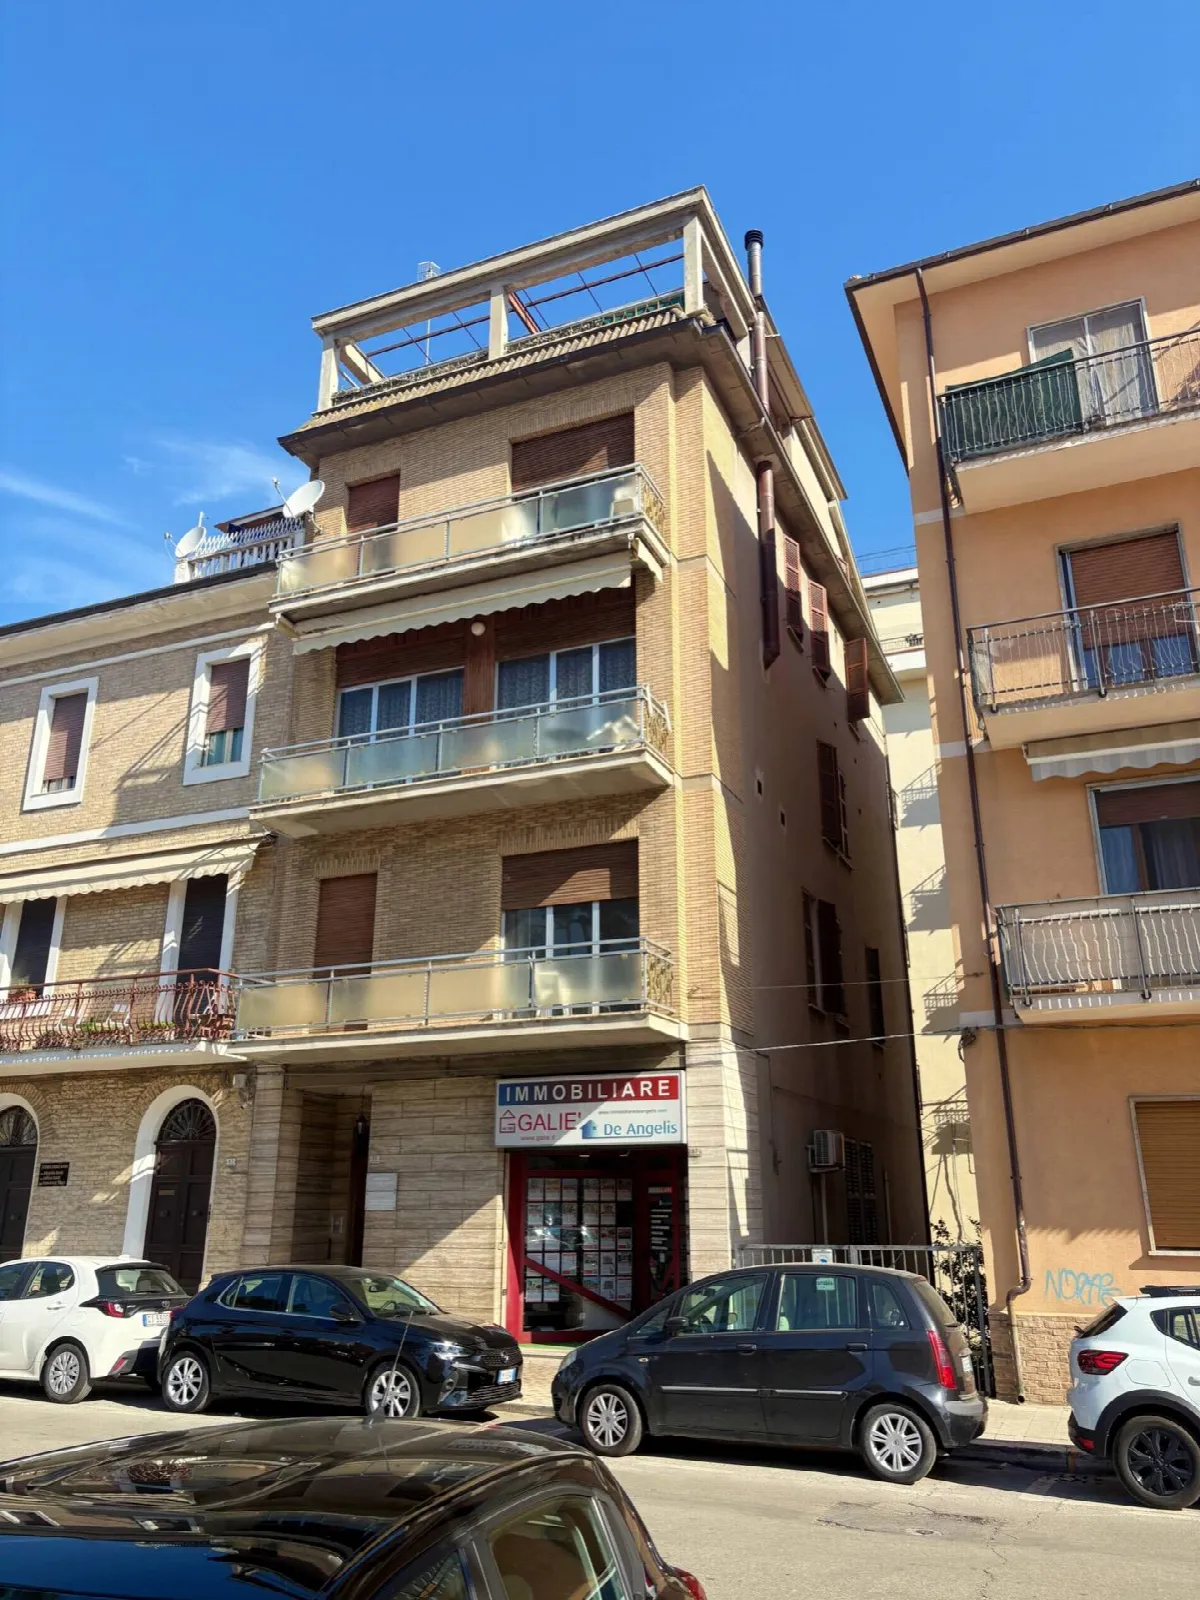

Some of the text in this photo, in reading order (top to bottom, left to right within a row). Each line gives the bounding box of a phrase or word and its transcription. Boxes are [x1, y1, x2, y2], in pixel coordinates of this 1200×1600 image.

[506, 1079, 670, 1102] IMMOBILIARE
[604, 1120, 678, 1137] De Angelis
